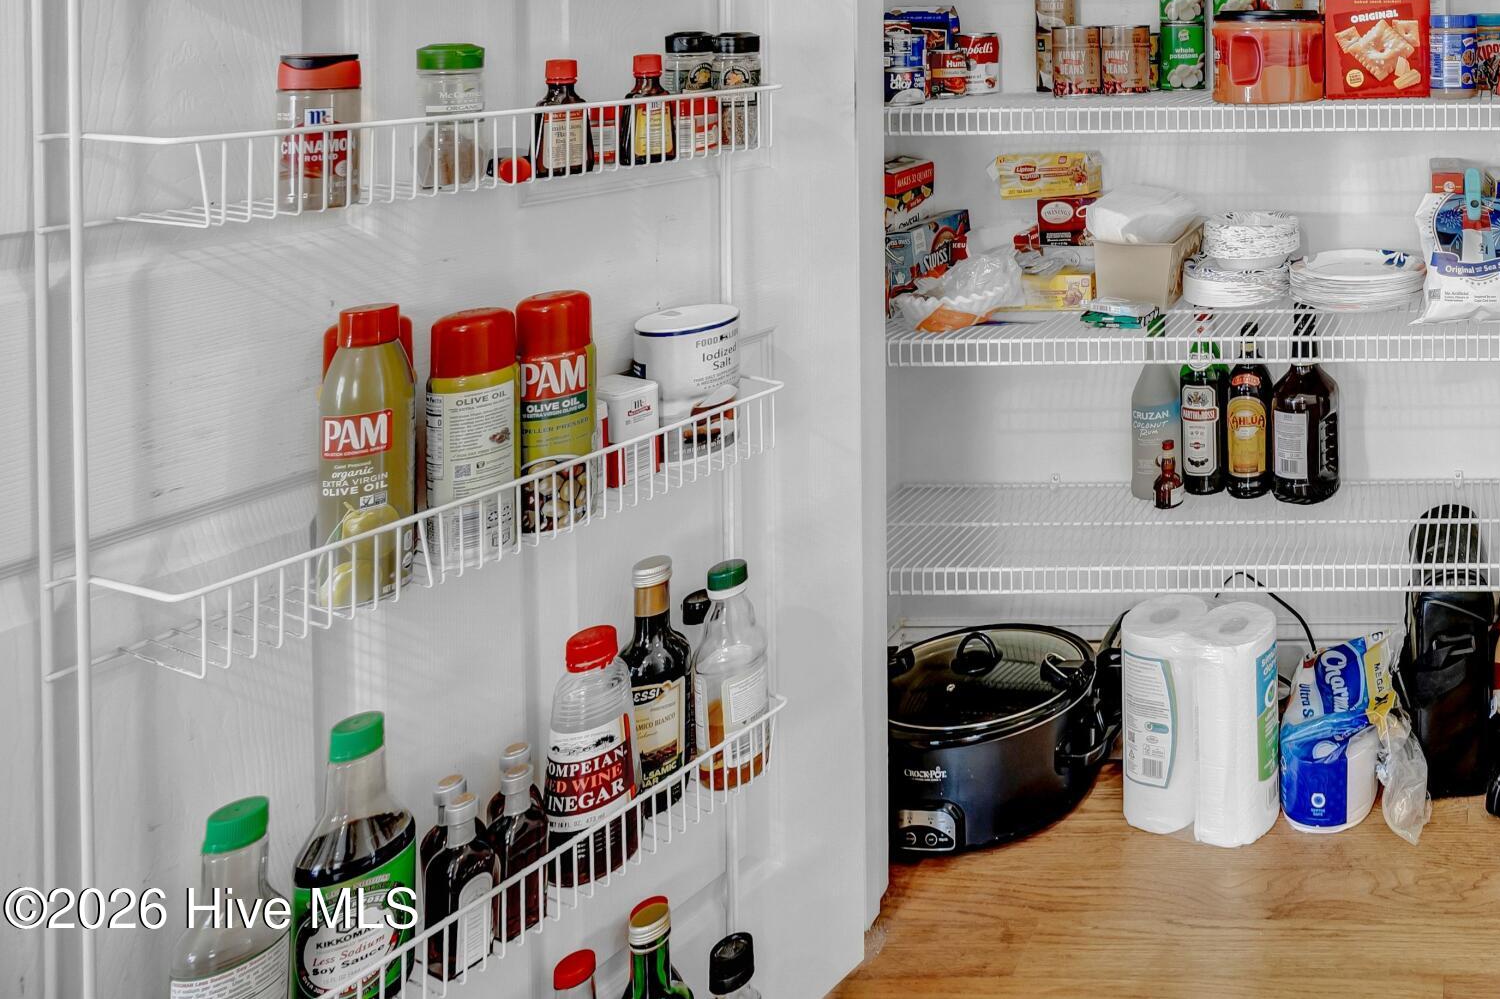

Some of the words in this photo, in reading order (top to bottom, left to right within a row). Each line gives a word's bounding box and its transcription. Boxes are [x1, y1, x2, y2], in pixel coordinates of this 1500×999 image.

[1350, 9, 1399, 24] ORIGINAL
[954, 41, 994, 56] Campbell's
[1058, 50, 1086, 62] KIDNEY
[1104, 50, 1130, 62] KIDNEY
[890, 73, 901, 82] LA
[1059, 63, 1085, 75] BEANS
[1106, 63, 1129, 75] BEANS
[890, 80, 912, 90] CHOY
[280, 135, 357, 156] CINNAMON
[1015, 166, 1036, 174] Lipton
[1044, 206, 1072, 219] TWININGS
[923, 247, 948, 272] SWISS
[1445, 264, 1475, 275] Original
[1484, 263, 1497, 271] Sea
[695, 335, 719, 349] FOOD
[701, 341, 737, 363] Iodized
[712, 357, 732, 371] Salt
[520, 353, 586, 399] PAM
[455, 394, 488, 407] OLIVE
[491, 390, 506, 401] OIL
[526, 400, 560, 413] OLIVE
[562, 398, 580, 409] OIL
[1133, 410, 1169, 421] CRUZAN
[323, 412, 389, 453] PAM
[1133, 420, 1169, 430] COCONUT
[322, 479, 349, 489] EXTRA
[352, 471, 389, 486] VIRGIN
[331, 465, 374, 482] organic
[322, 485, 359, 498] OLIVE
[363, 479, 388, 492] OIL
[1373, 662, 1385, 693] MEGA
[632, 687, 660, 704] ESSI
[1298, 683, 1311, 709] Ultra
[654, 711, 677, 727] BIANCO
[547, 743, 628, 778] OMPEIAN
[547, 777, 569, 794] ED
[571, 762, 624, 792] WINE
[642, 762, 678, 781] LSAMIC
[547, 779, 626, 813] INEGAR
[312, 951, 338, 967] Less
[340, 933, 386, 958] Sodium
[310, 963, 337, 977] Soy
[340, 944, 386, 967] Sauce
